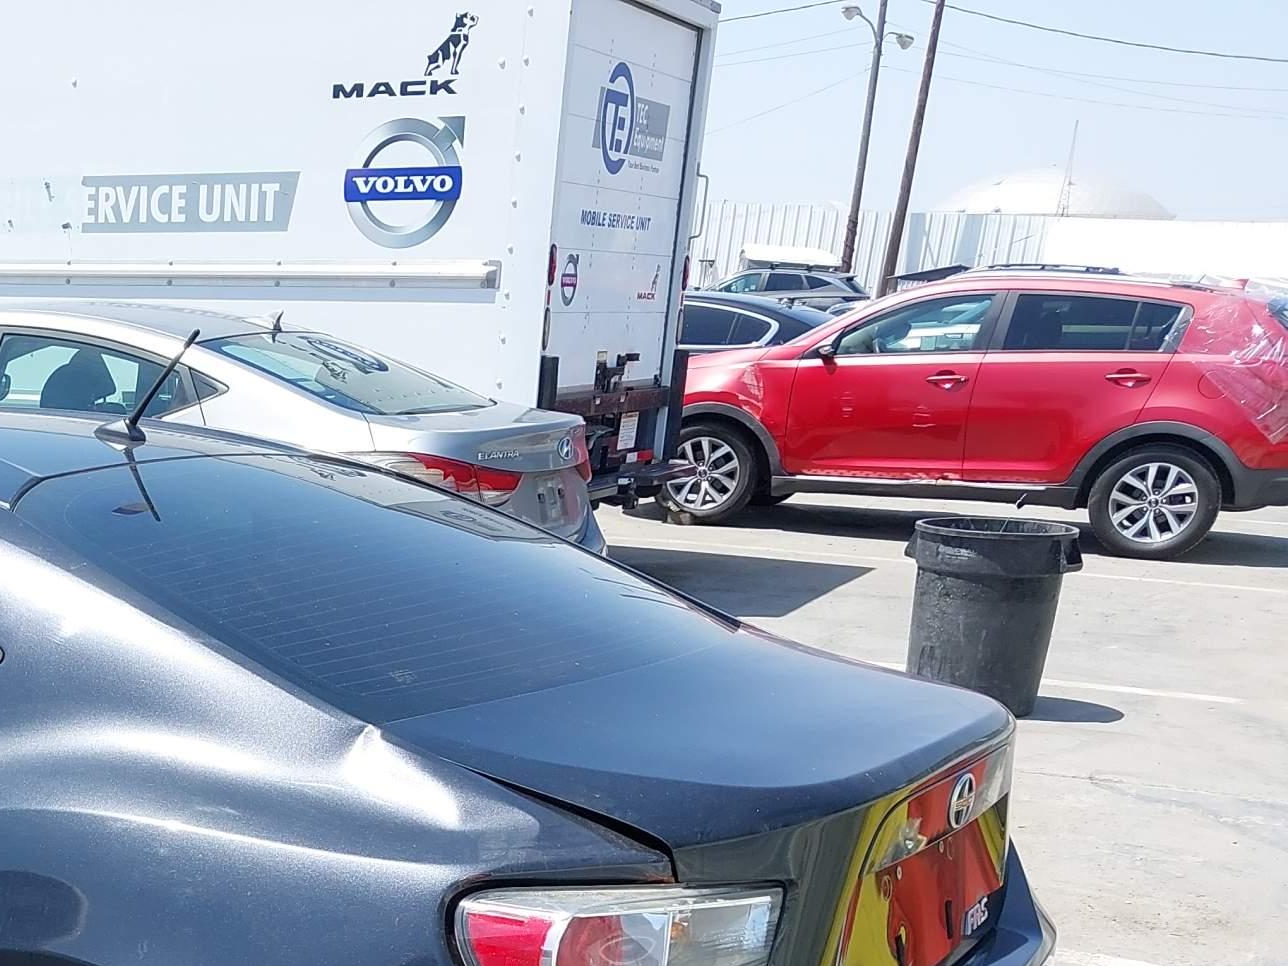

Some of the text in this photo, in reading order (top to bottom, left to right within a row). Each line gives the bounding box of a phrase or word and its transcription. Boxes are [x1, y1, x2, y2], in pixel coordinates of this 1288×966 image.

[332, 79, 458, 99] MACK
[637, 102, 649, 124] TEC
[352, 175, 453, 194] VOLVO
[82, 185, 188, 225] ERVICE
[198, 183, 280, 223] UNIT
[580, 209, 652, 231] MOBILE SERVICE UNIT
[637, 292, 656, 301] MACK
[477, 450, 520, 461] ELANTRA
